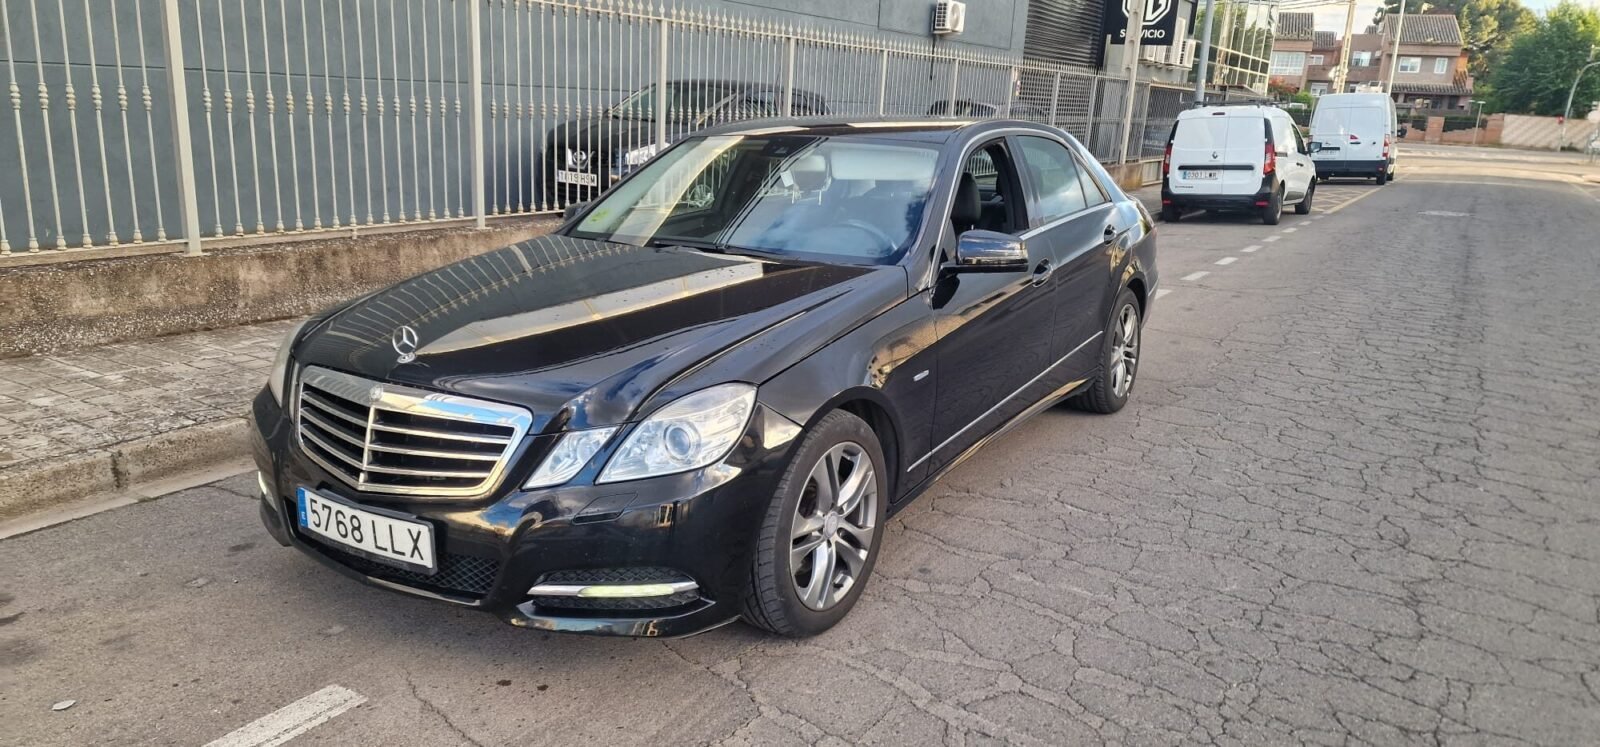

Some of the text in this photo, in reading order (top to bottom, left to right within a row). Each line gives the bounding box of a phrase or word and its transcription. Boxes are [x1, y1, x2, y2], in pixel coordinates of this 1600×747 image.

[1119, 28, 1166, 39] SVICIO
[310, 498, 424, 561] 5768 LLX
